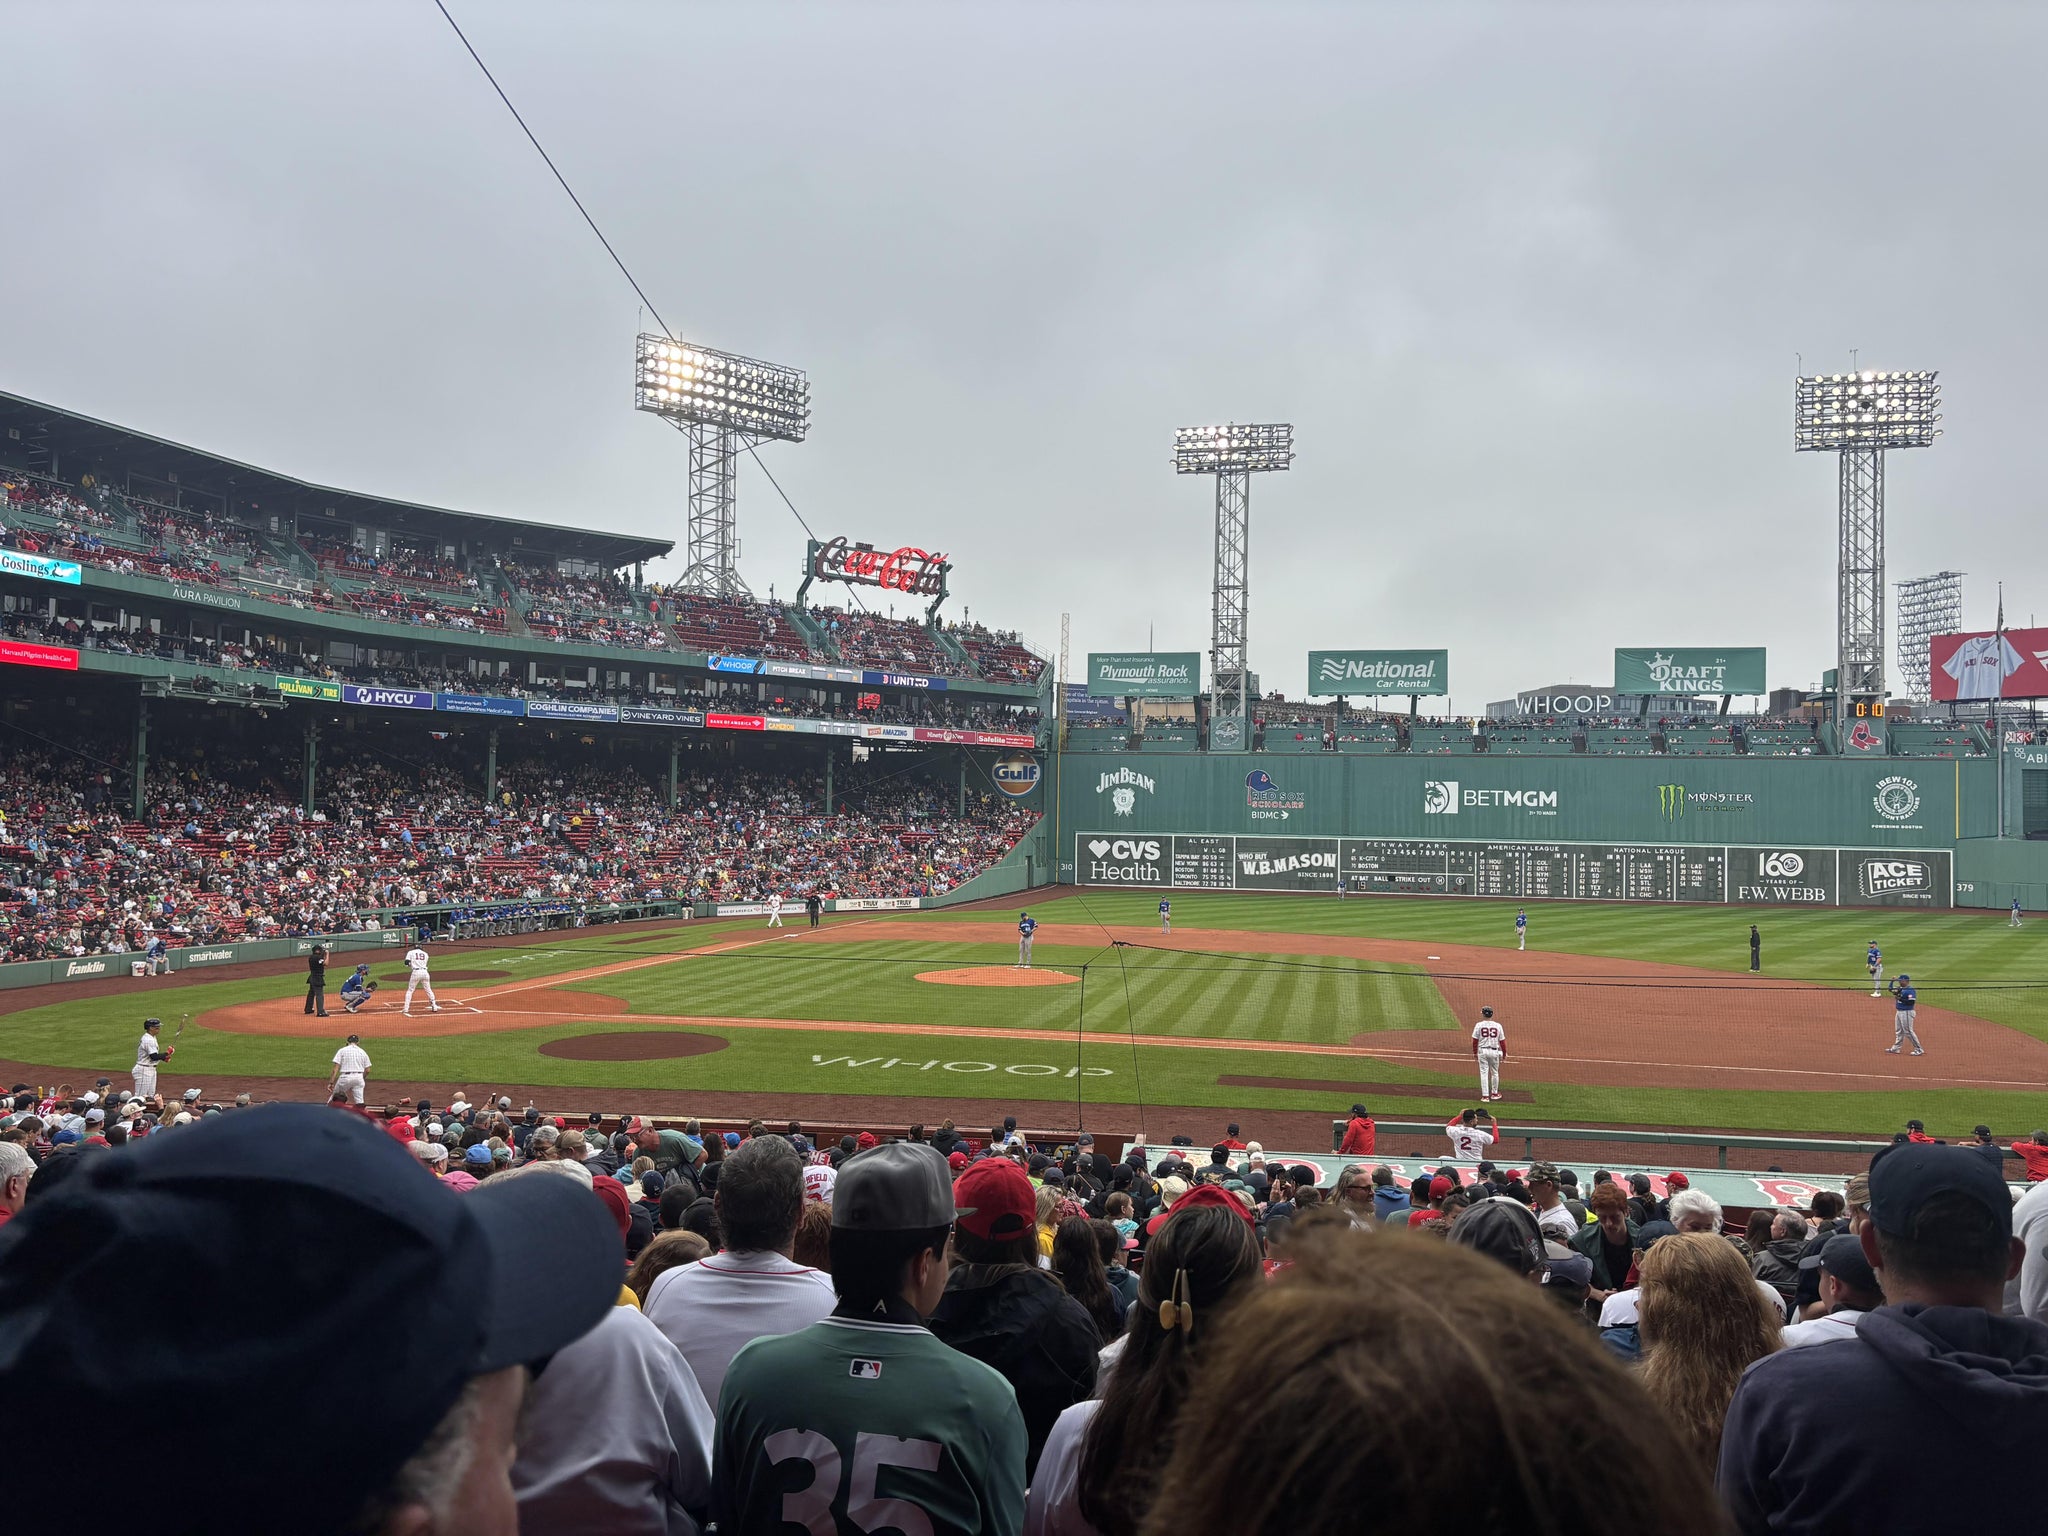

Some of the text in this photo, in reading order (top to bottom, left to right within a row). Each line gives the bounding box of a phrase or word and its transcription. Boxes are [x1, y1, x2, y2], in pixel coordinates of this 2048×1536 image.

[2, 556, 50, 577] Goslings
[816, 536, 948, 595] Coca-Cola
[204, 593, 240, 608] PAVILION
[2, 648, 23, 657] Harvard
[23, 650, 43, 659] Pilgrim
[43, 652, 60, 661] Health
[722, 661, 752, 670] WHOOP
[1983, 657, 1998, 667] SOX
[1100, 664, 1188, 679] Plymouth Rock
[1650, 665, 1726, 681] DRAFT
[893, 676, 929, 688] UNITED
[1376, 680, 1430, 688] Car Rental
[1660, 678, 1724, 691] KINGS
[278, 682, 338, 697] SULLIVAN TIRE
[375, 692, 414, 704] HYCU
[1516, 695, 1611, 714] WHOOP
[530, 702, 617, 715] COGHLIN COMPANIES
[631, 712, 700, 723] VINEYARD VINES
[882, 729, 908, 737] AMAZING
[978, 735, 1006, 744] Safelite
[994, 764, 1037, 780] Gulf
[1096, 767, 1156, 794] JIM BEAM
[1875, 776, 1918, 790] IBEW 103
[1252, 792, 1305, 801] RED SOX
[1464, 790, 1558, 808] BETMGM
[1688, 792, 1754, 803] MONSTER
[1252, 801, 1305, 809] SCHOLARS
[1252, 811, 1279, 819] BIDMC
[1111, 840, 1160, 860] CVS
[1061, 863, 1073, 871] 310
[1242, 853, 1337, 875] W.B.MASON
[1760, 852, 1804, 877] 160
[1873, 862, 1922, 879] ACE
[1090, 861, 1160, 881] Health
[1874, 878, 1923, 889] TICKET
[1956, 883, 1974, 892] 379
[1738, 886, 1826, 901] F.W. WEBB
[189, 950, 233, 963] smartwater
[415, 952, 425, 960] 19
[1481, 1027, 1498, 1038] 83
[811, 1054, 1114, 1078] WHOOP
[37, 1106, 51, 1115] 34
[1460, 1136, 1472, 1150] 2
[764, 1427, 942, 1536] 35
